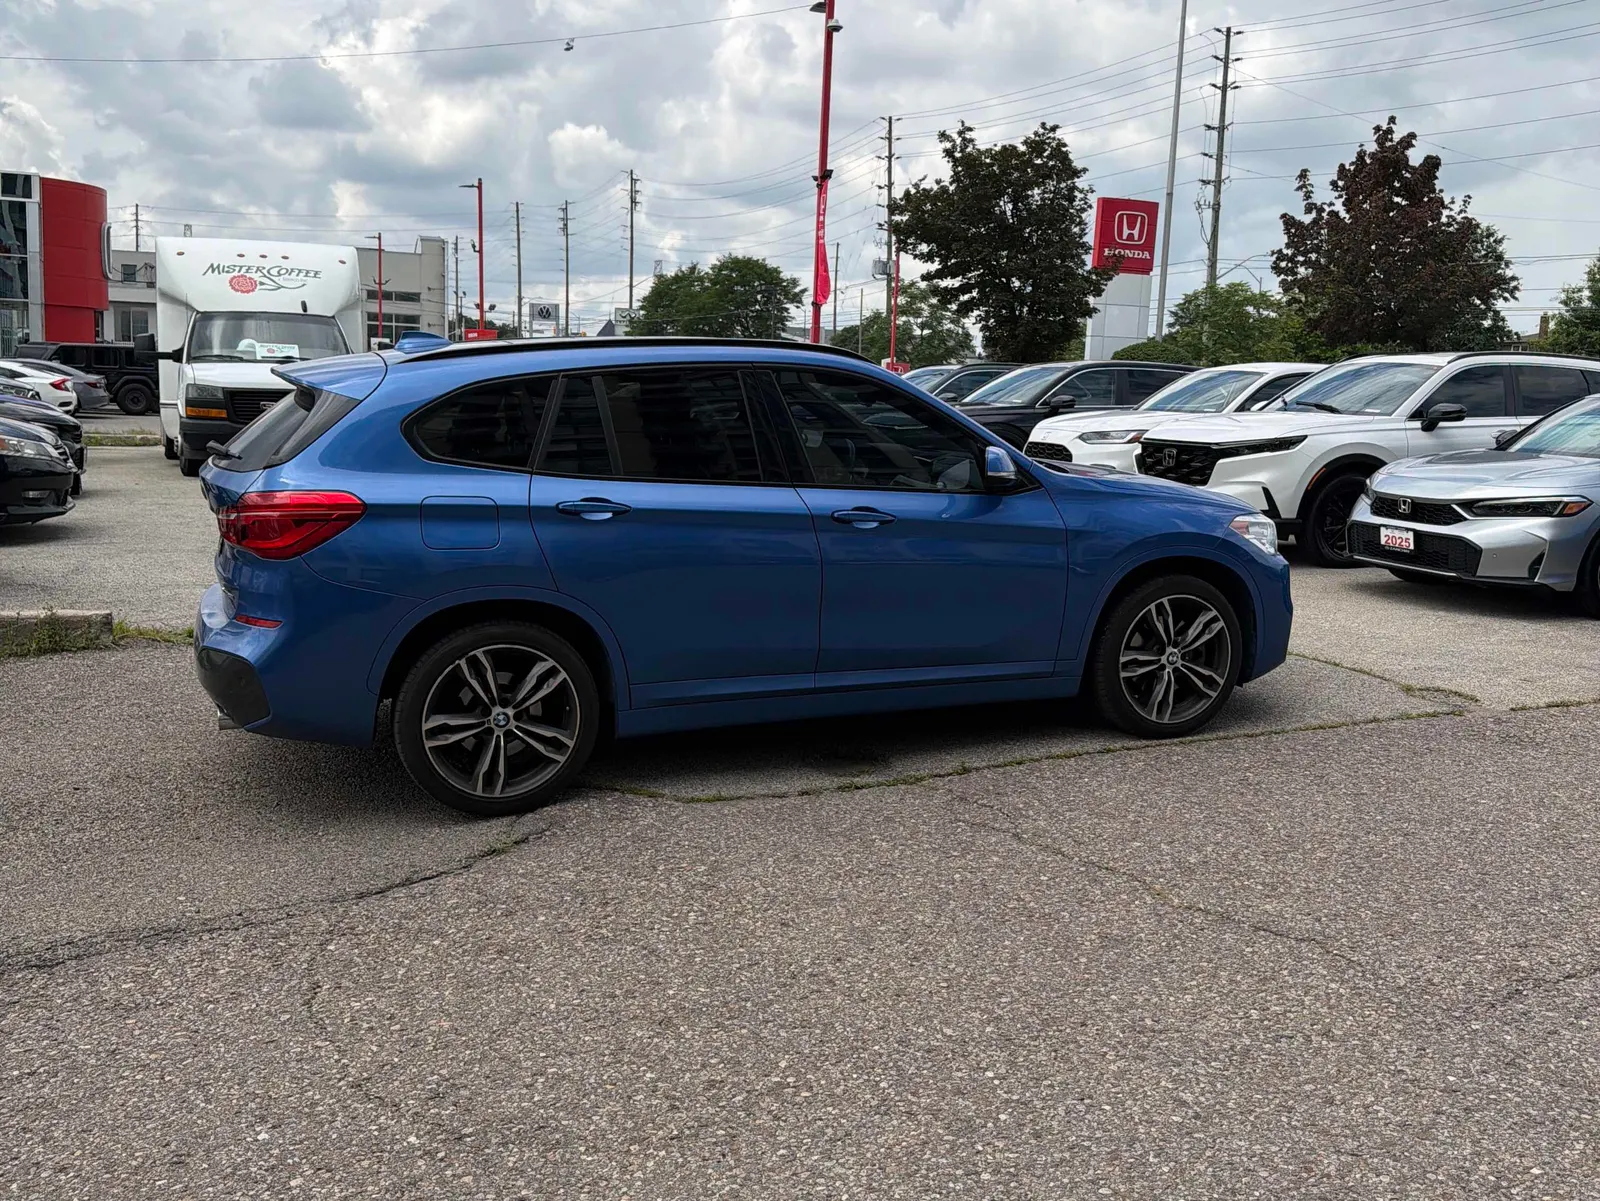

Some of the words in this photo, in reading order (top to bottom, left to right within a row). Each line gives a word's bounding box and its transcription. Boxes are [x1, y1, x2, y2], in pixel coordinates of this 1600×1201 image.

[1103, 248, 1151, 260] HONDA
[202, 263, 266, 276] MISTER
[267, 265, 322, 279] COFFEE
[1384, 534, 1411, 549] 2025
